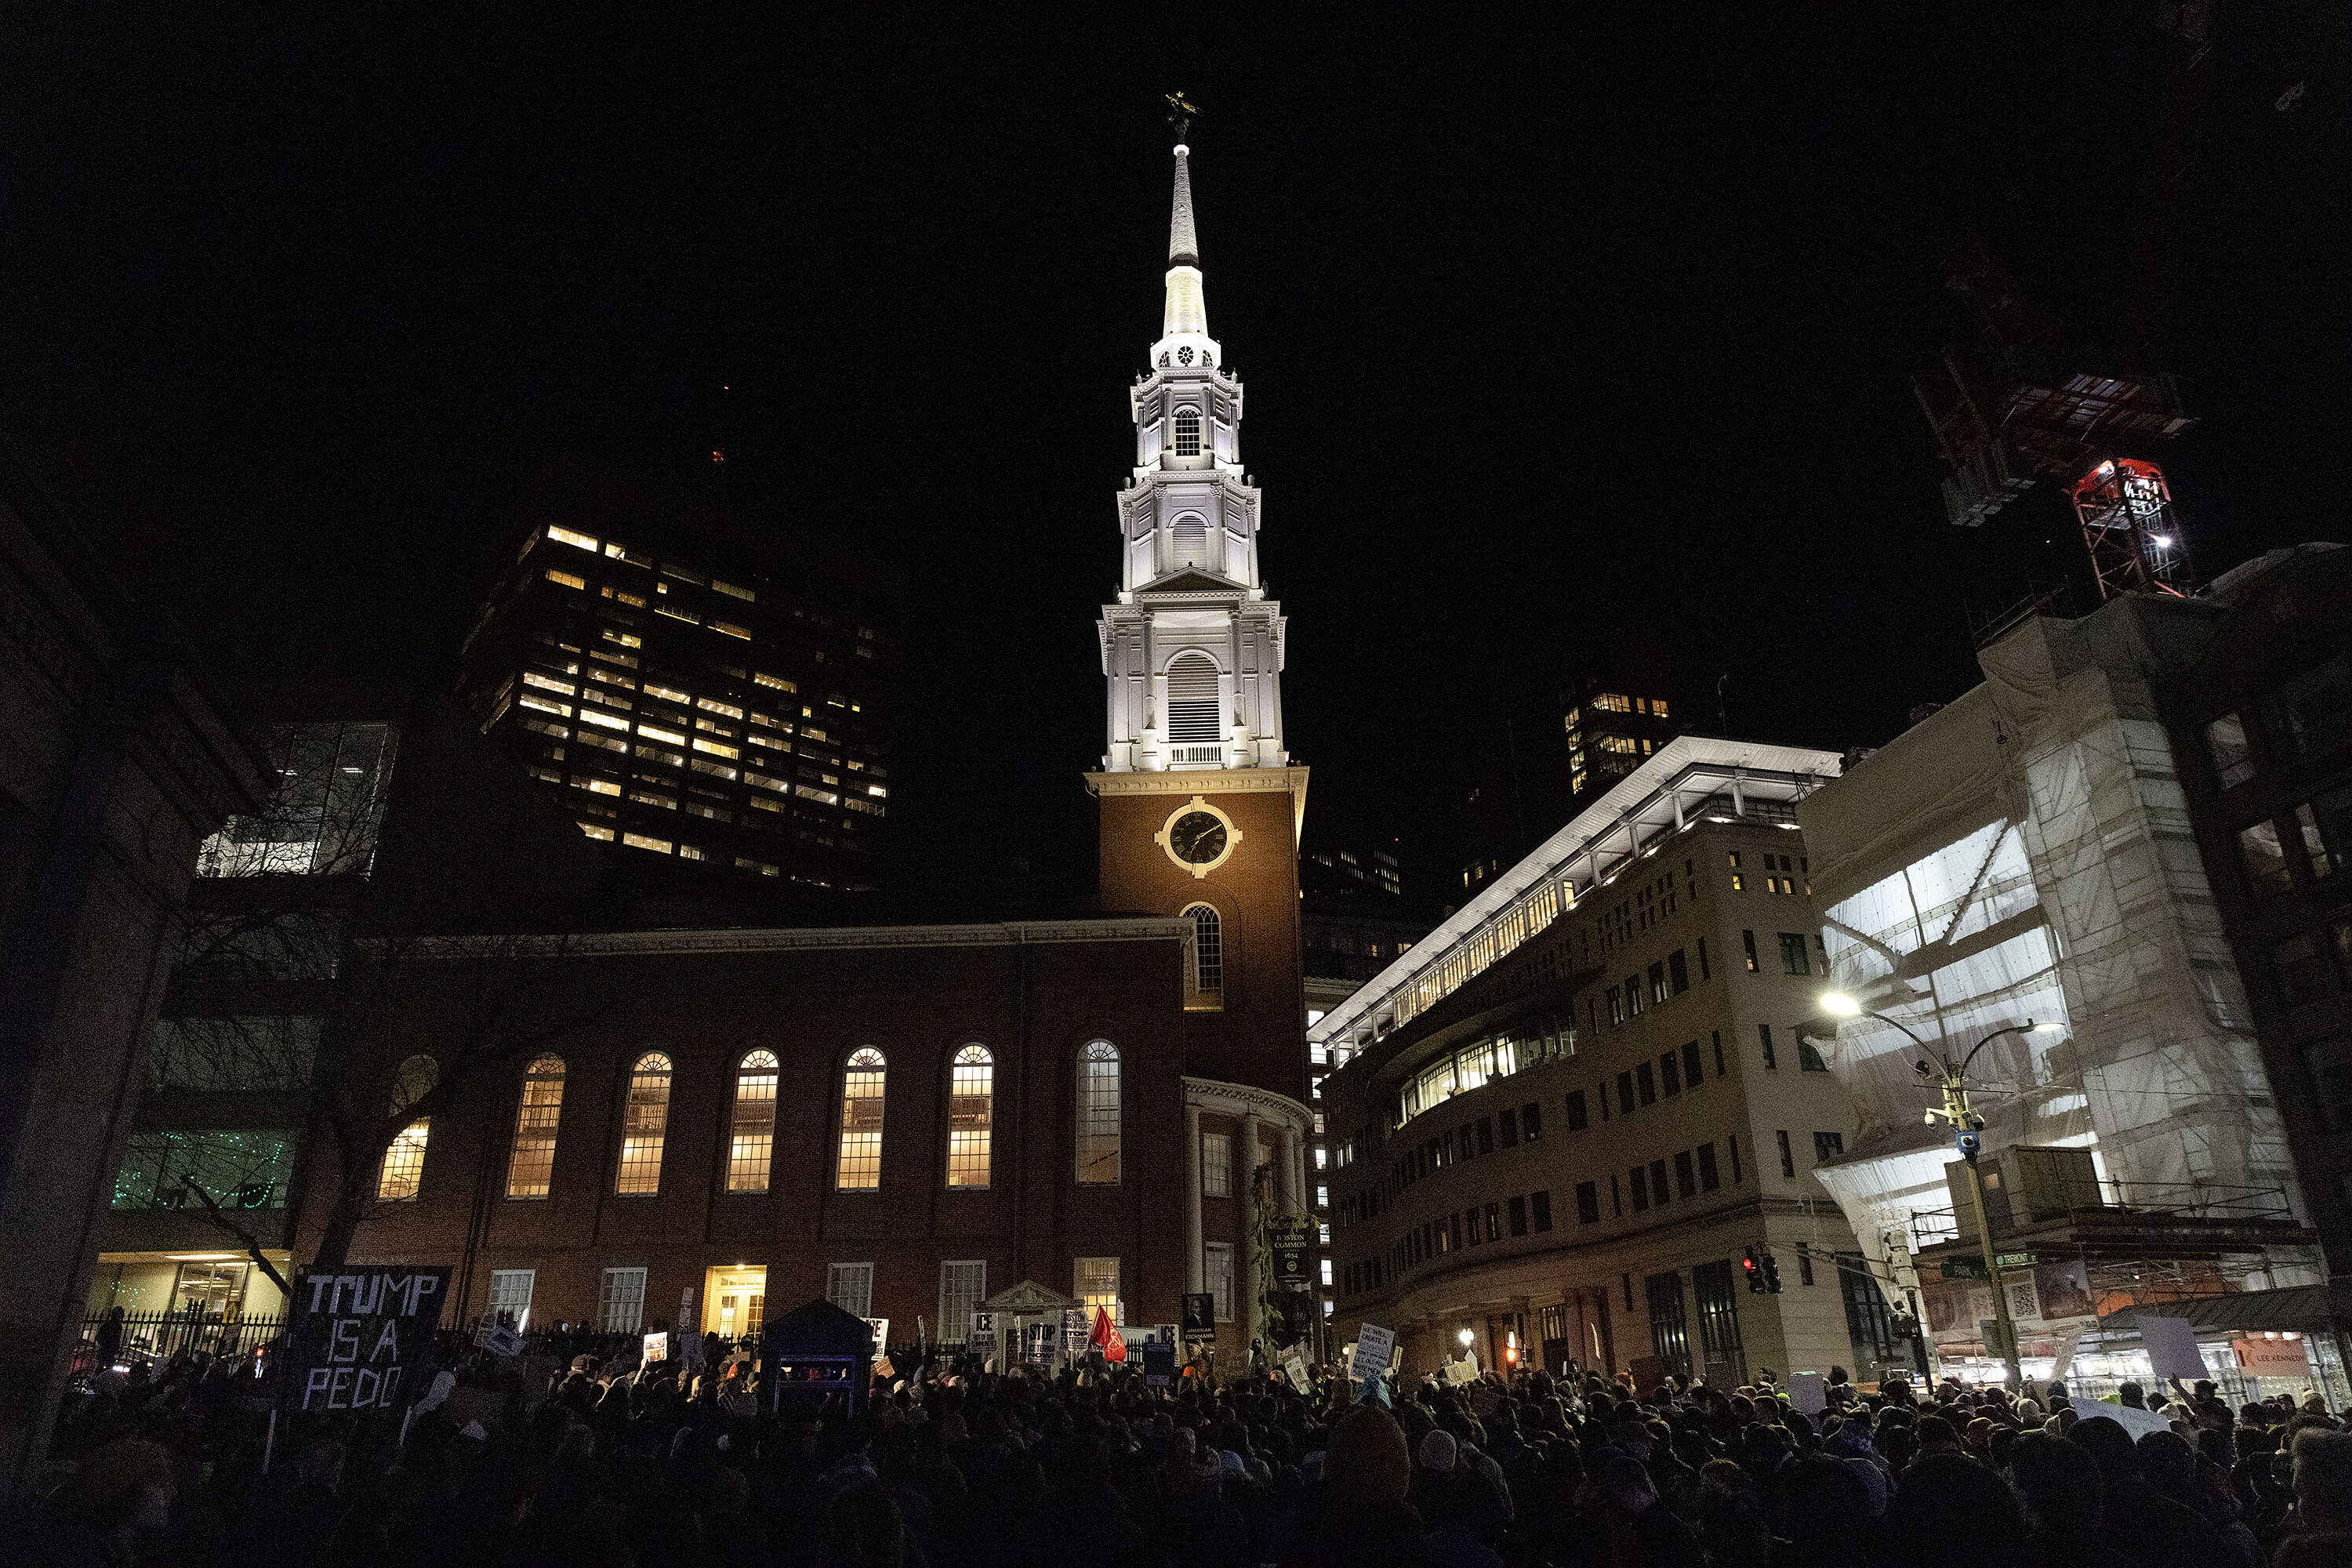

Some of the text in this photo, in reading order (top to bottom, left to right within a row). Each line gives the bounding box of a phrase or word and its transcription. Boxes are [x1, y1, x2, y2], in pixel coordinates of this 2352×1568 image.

[2003, 1253, 2028, 1264] TREMONT
[1954, 1265, 1972, 1276] PARK
[976, 1314, 993, 1331] ICE
[1063, 1313, 1086, 1322] BOSTON
[1029, 1323, 1055, 1341] STOP
[1160, 1326, 1175, 1344] ICE
[1373, 1328, 1388, 1338] WILL
[327, 1319, 397, 1363] IS A
[1361, 1334, 1381, 1345] CREATE
[1367, 1367, 1381, 1375] MEN
[302, 1366, 402, 1410] PEDO
